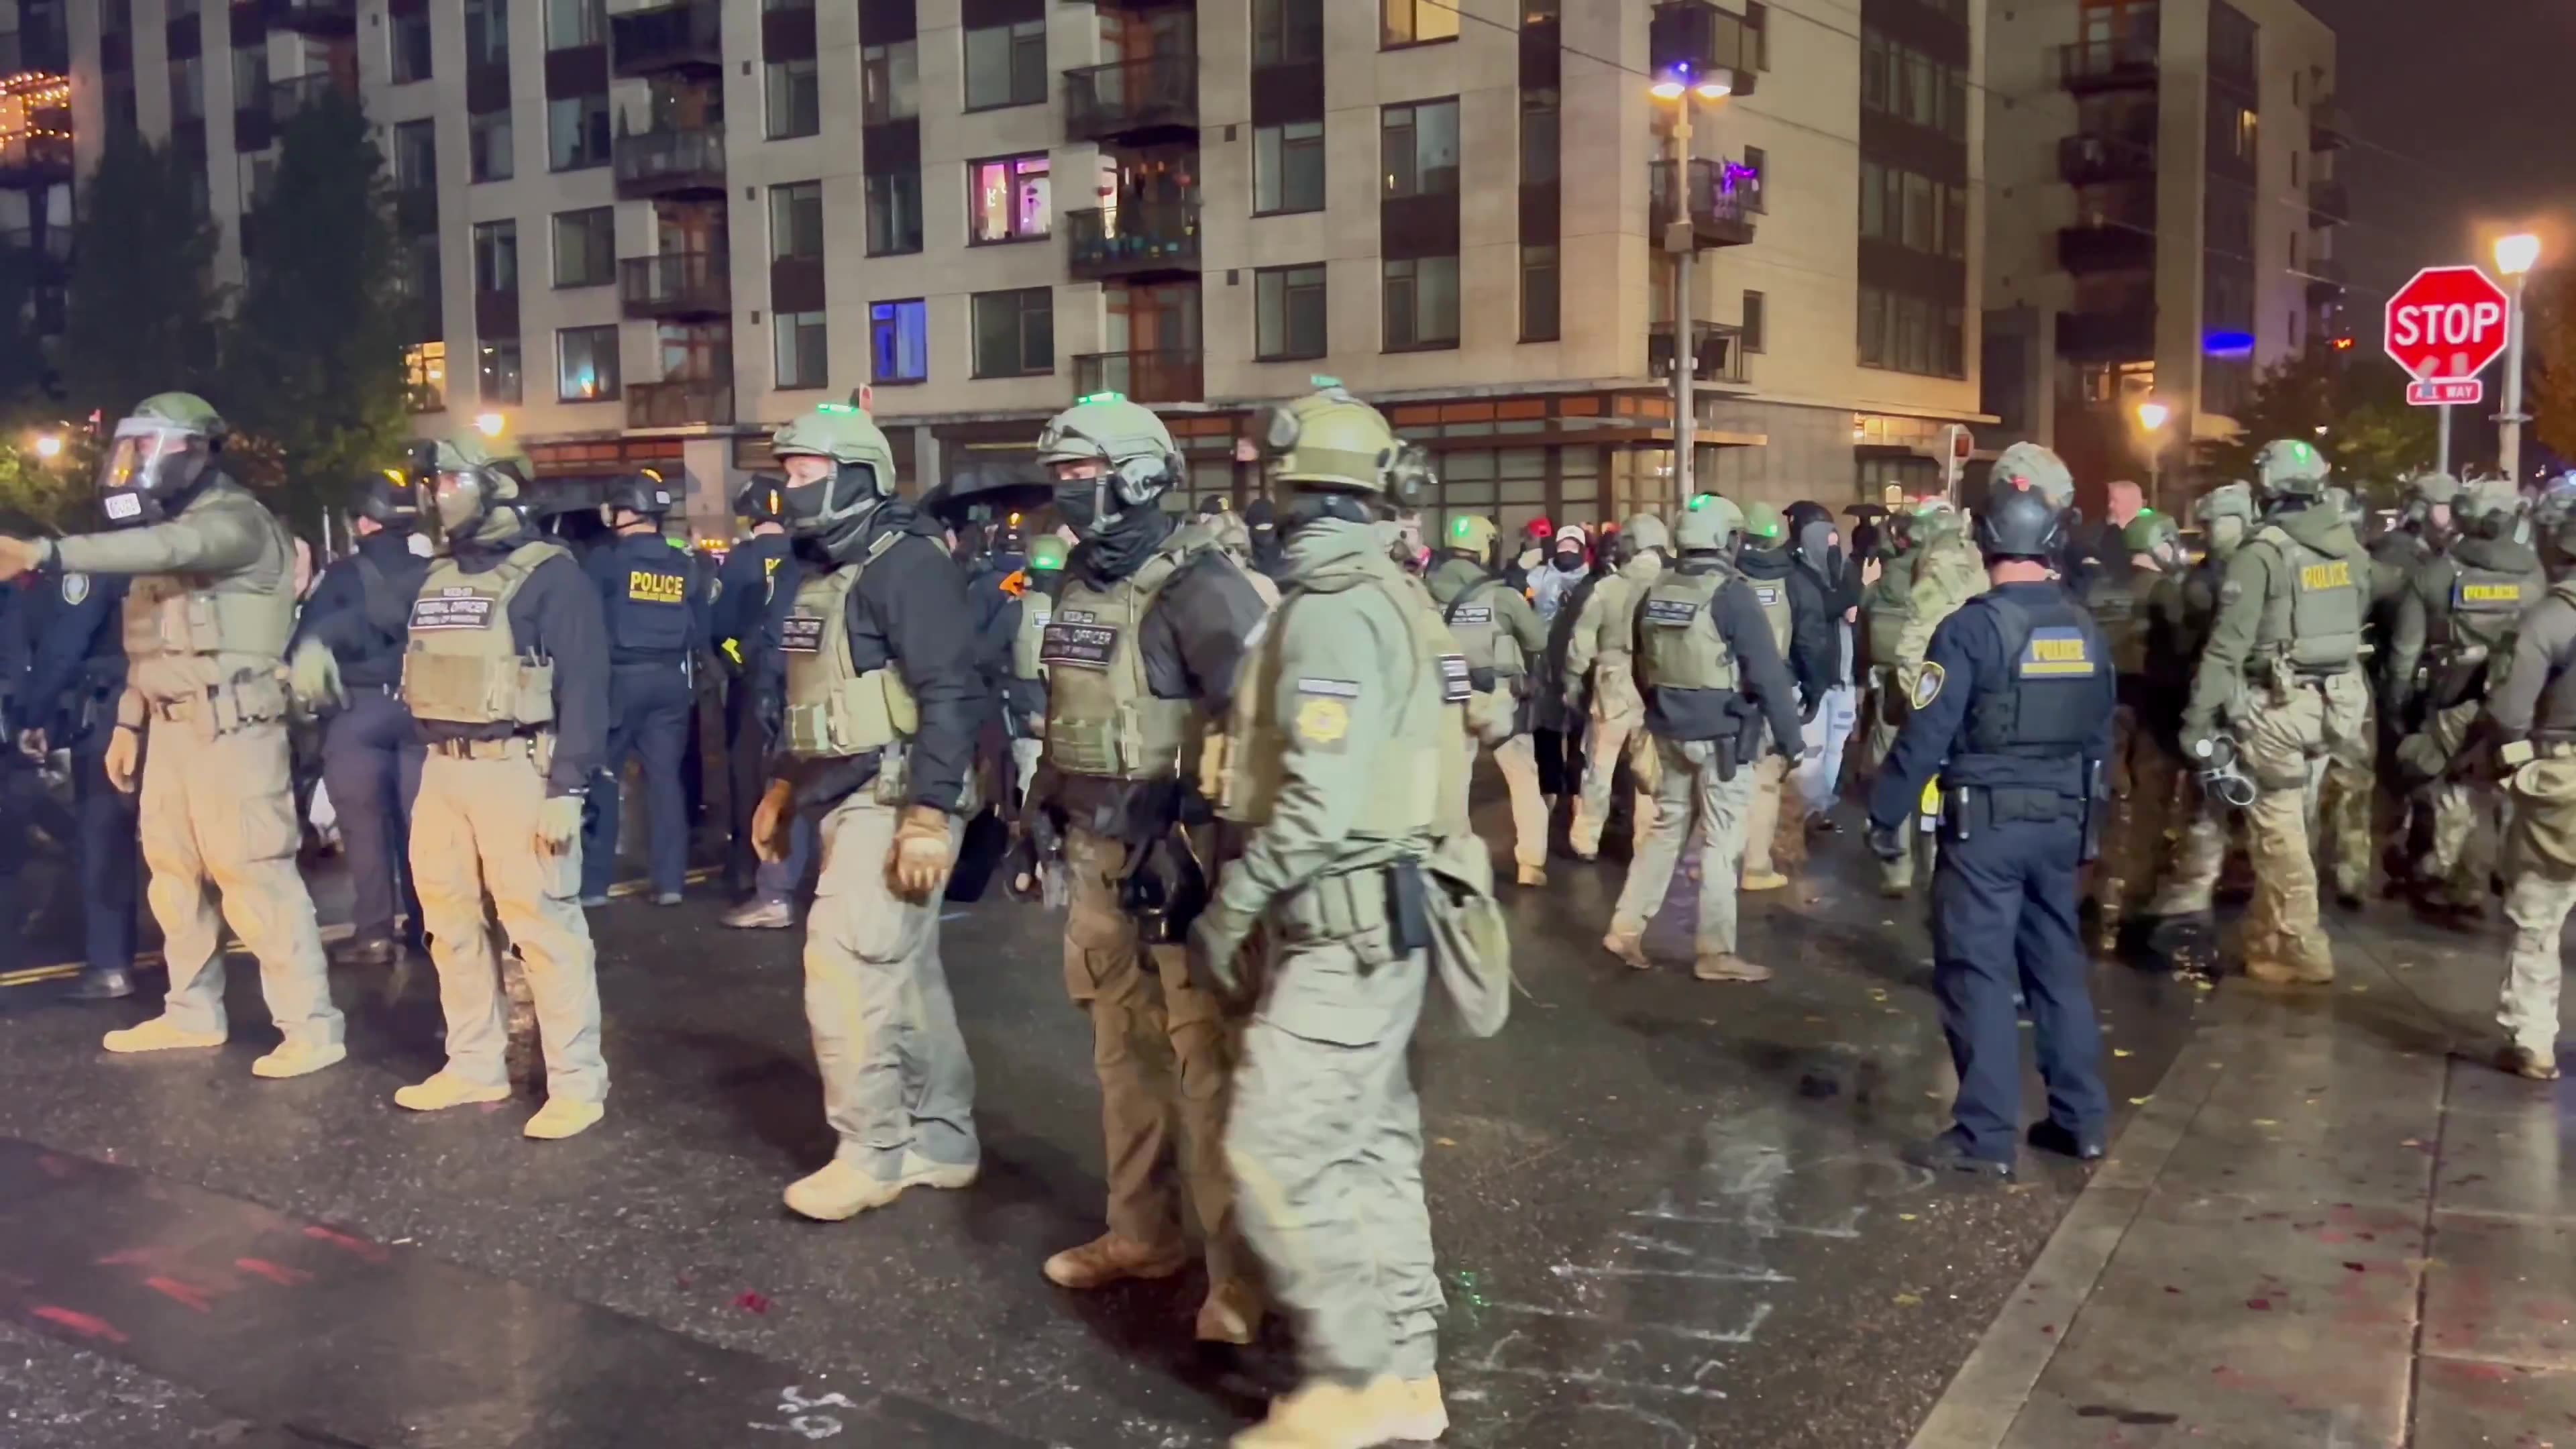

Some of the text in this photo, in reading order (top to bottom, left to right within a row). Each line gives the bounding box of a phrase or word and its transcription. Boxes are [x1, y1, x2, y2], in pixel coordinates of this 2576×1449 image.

[2394, 302, 2500, 346] STOP
[2446, 385, 2474, 398] WAY
[765, 557, 782, 575] P
[630, 571, 684, 595] POLICE
[2301, 561, 2351, 593] POLICE
[2463, 585, 2520, 600] POLICE
[1072, 629, 1112, 645] OFFICER
[2032, 639, 2085, 661] POLICE
